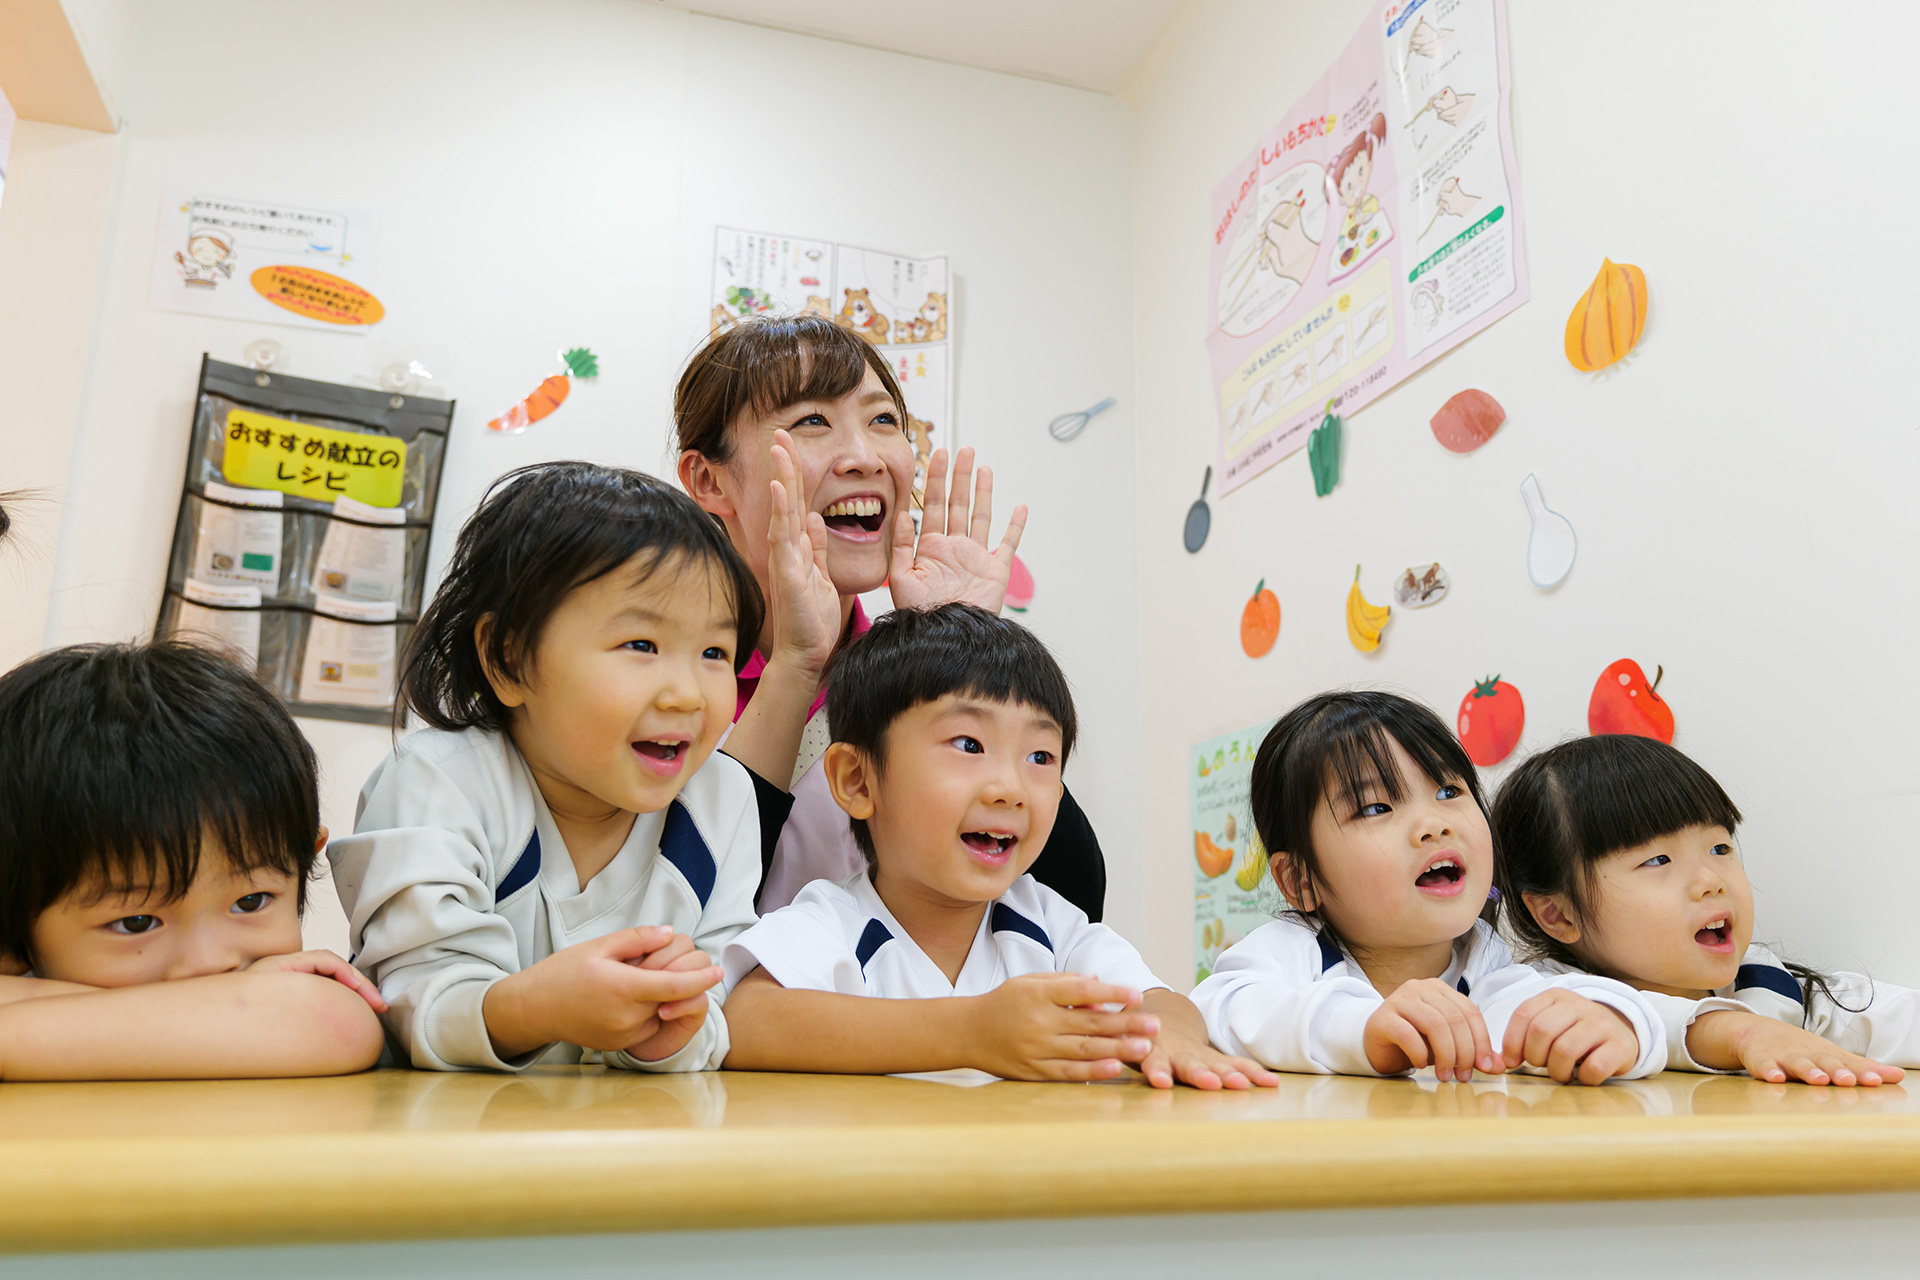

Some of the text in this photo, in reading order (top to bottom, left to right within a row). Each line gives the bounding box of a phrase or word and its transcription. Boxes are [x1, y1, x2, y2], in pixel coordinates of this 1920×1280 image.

[229, 420, 401, 470] おすすめ献立の
[276, 460, 351, 493] レシピ
